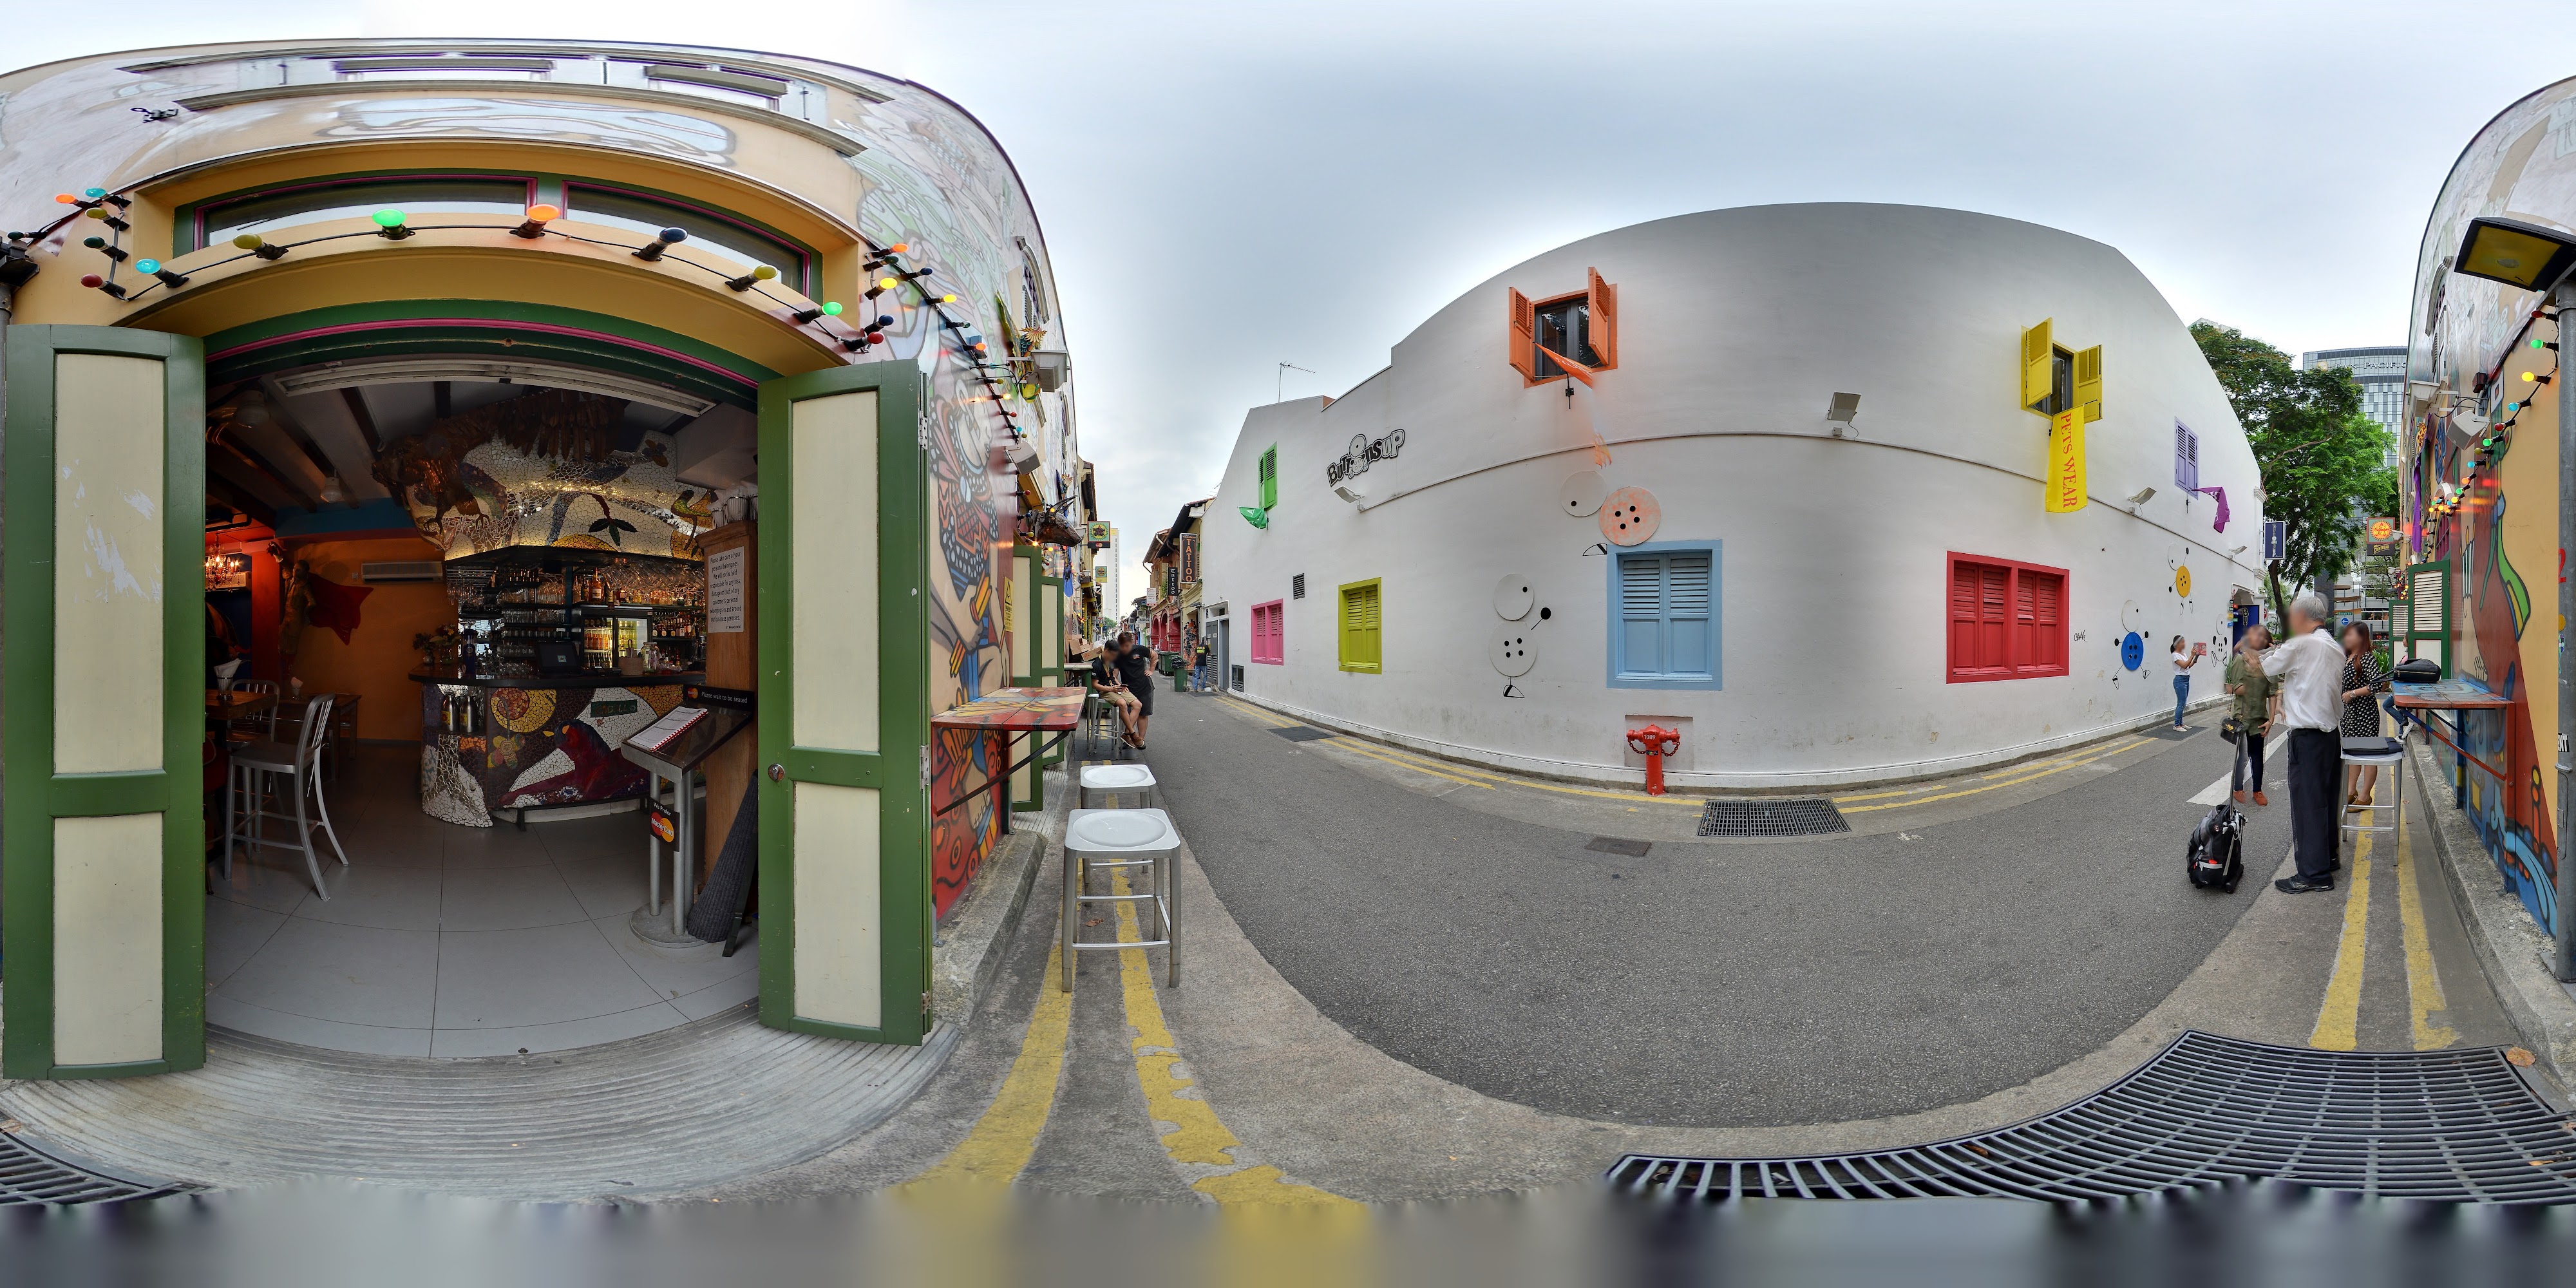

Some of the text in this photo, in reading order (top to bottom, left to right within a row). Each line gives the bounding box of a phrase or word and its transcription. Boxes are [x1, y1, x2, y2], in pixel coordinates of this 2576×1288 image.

[2363, 361, 2407, 370] PACIFIC
[2061, 412, 2078, 508] PETS WEAR
[726, 596, 738, 605] personal
[653, 801, 671, 816] We Prefer
[651, 817, 674, 837] MasterCard
